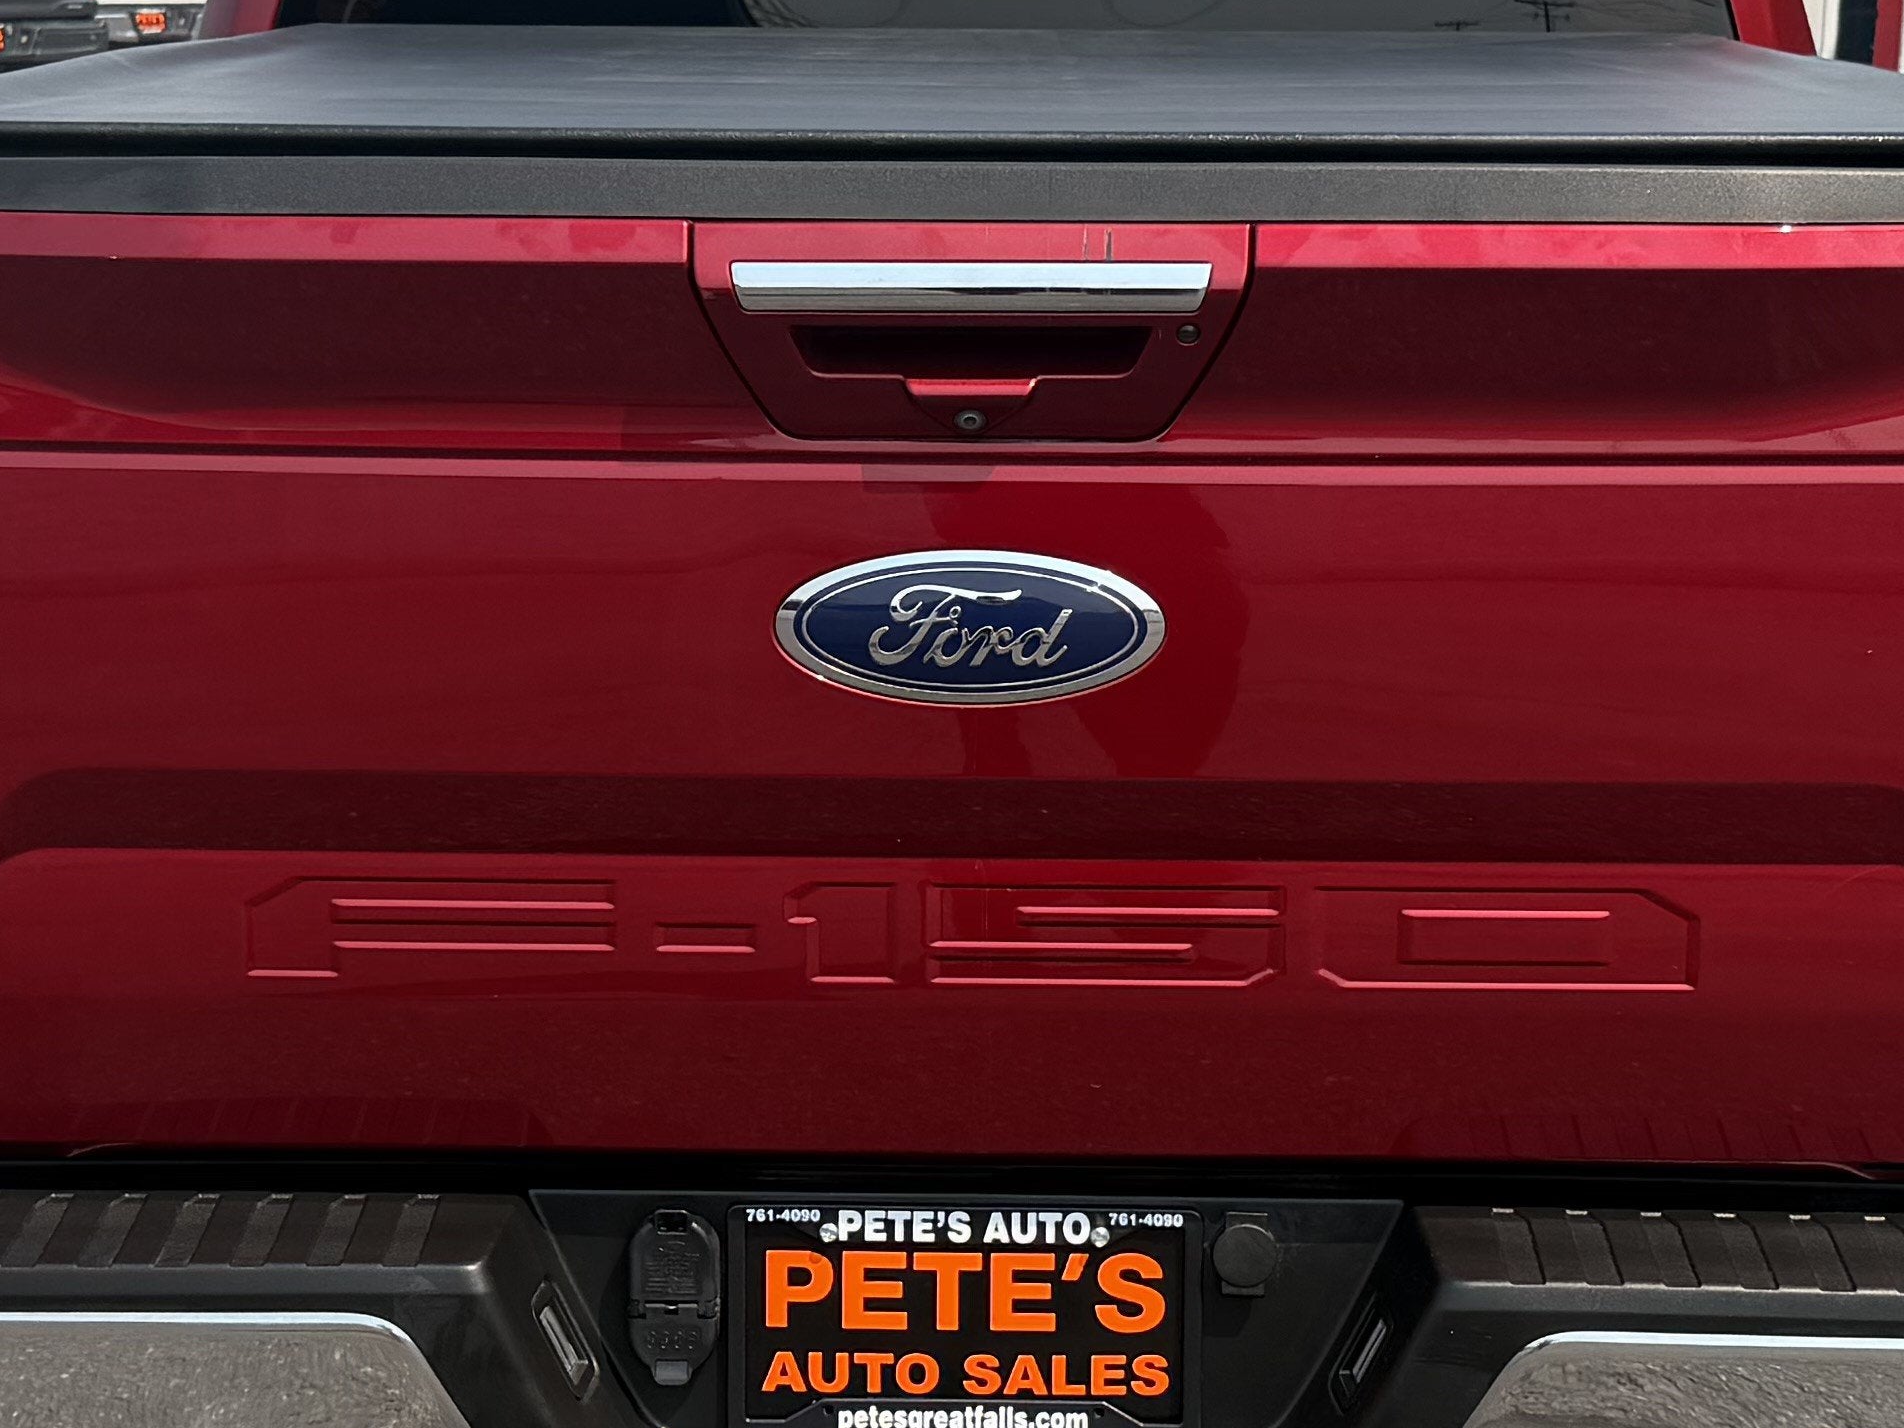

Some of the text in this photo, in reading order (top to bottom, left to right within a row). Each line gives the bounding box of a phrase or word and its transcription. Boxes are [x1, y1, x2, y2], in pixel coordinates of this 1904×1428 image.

[868, 584, 1073, 667] Ford
[246, 876, 1696, 990] F-150
[746, 1208, 821, 1222] 761-4090
[837, 1209, 1091, 1245] PETE'S AUTO
[1108, 1212, 1183, 1228] 761-4090
[765, 1249, 1166, 1334] PETE'S
[761, 1351, 1170, 1396] AUTO SALES
